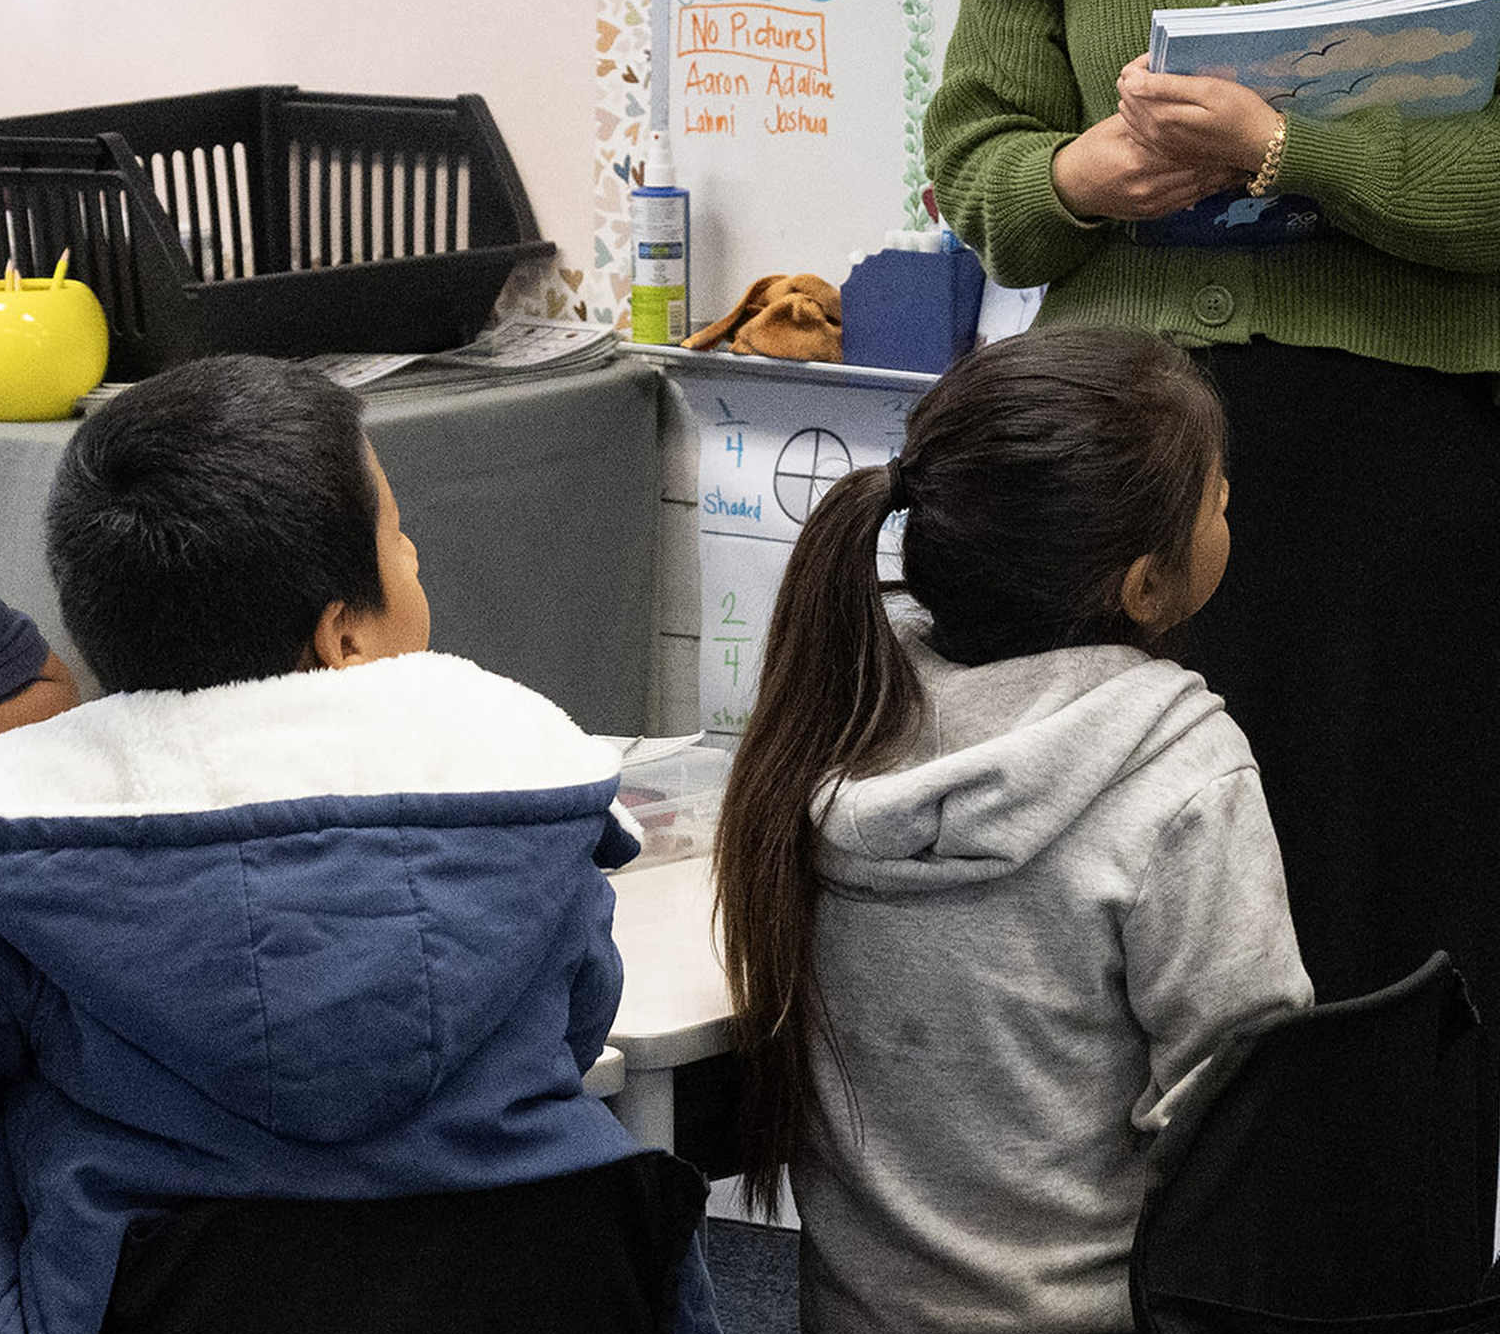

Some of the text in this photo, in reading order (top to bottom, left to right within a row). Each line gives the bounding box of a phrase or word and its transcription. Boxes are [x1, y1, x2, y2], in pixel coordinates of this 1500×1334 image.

[691, 12, 817, 51] No Pictures
[684, 61, 750, 95] Aaron
[764, 104, 829, 136] Joshua
[725, 431, 744, 468] 4
[702, 485, 762, 522] Shaded
[720, 591, 747, 626] 2
[724, 644, 741, 686] 4
